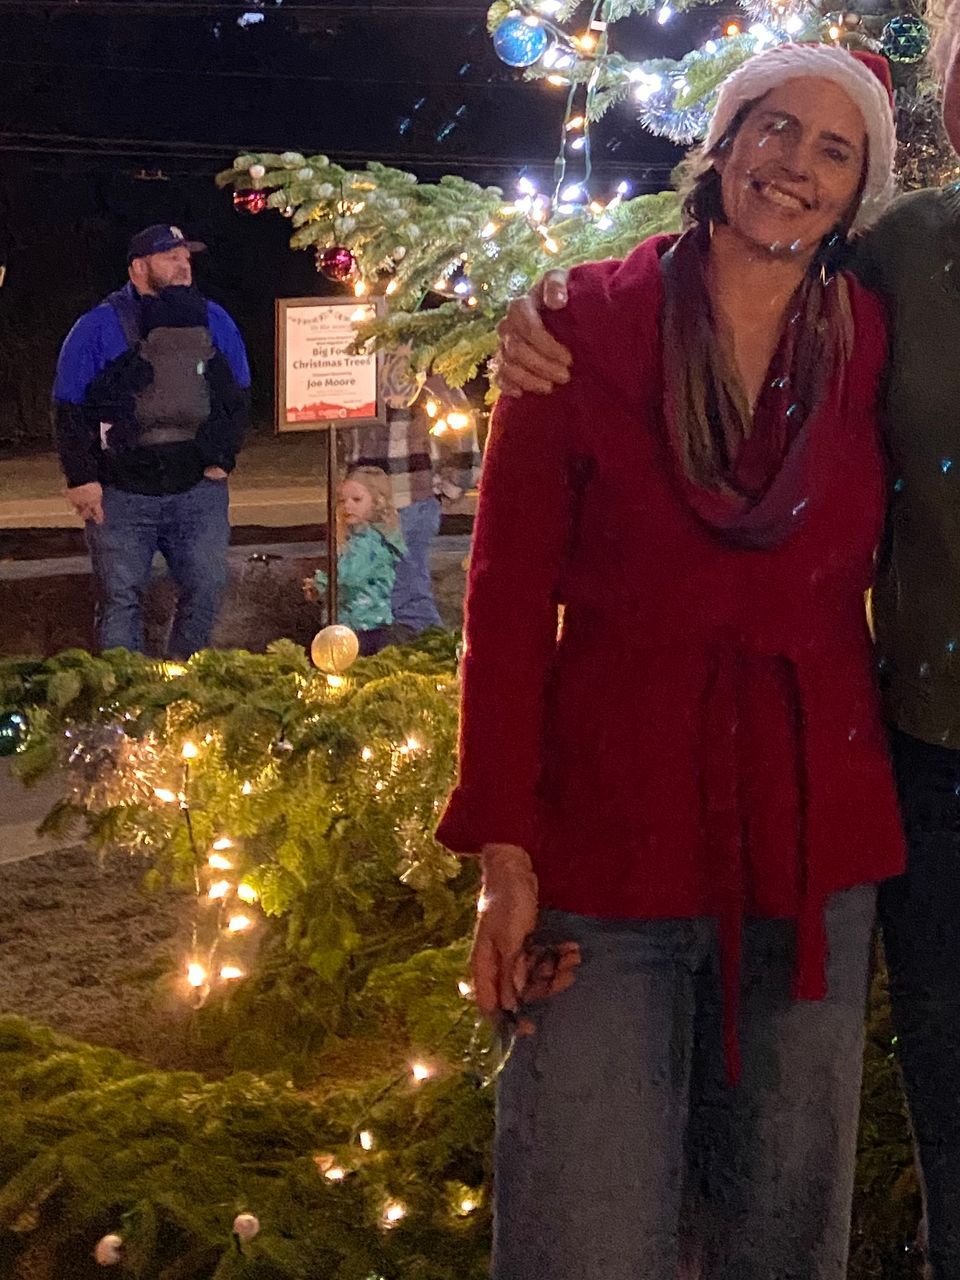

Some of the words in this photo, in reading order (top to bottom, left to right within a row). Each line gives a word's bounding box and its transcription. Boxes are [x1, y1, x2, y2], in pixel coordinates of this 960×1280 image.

[312, 346, 328, 358] Big
[293, 359, 342, 370] Christmas
[345, 358, 371, 367] Trees
[306, 379, 323, 390] Joe
[325, 378, 356, 387] Moore
